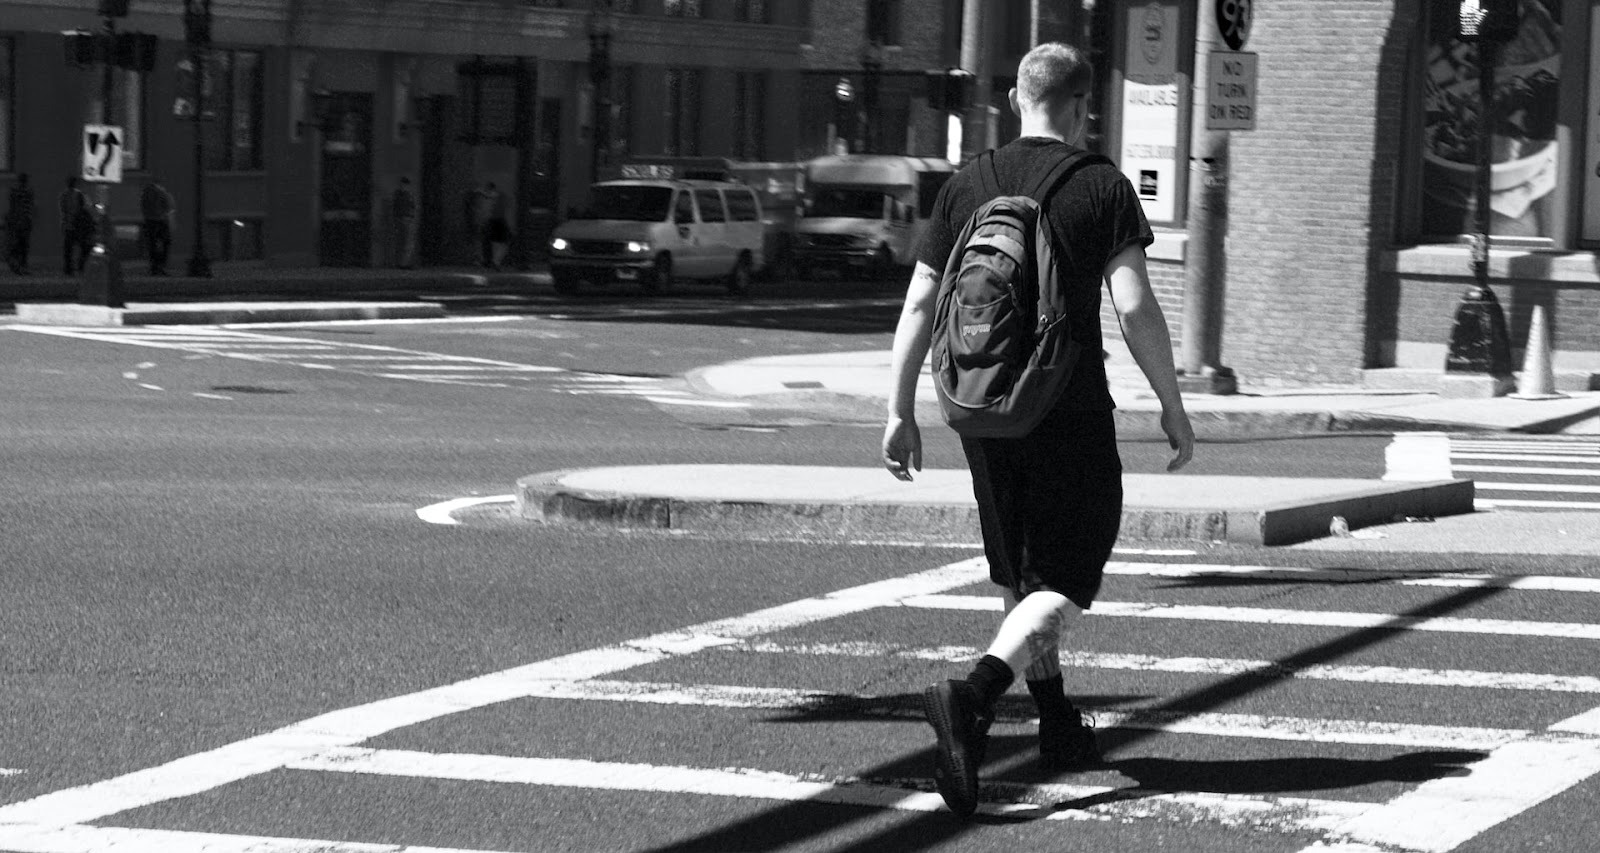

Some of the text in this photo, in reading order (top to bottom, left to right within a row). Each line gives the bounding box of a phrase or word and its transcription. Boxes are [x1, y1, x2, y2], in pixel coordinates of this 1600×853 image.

[1223, 61, 1242, 76] NO
[1217, 82, 1247, 98] TURN
[1209, 104, 1252, 120] ON RED
